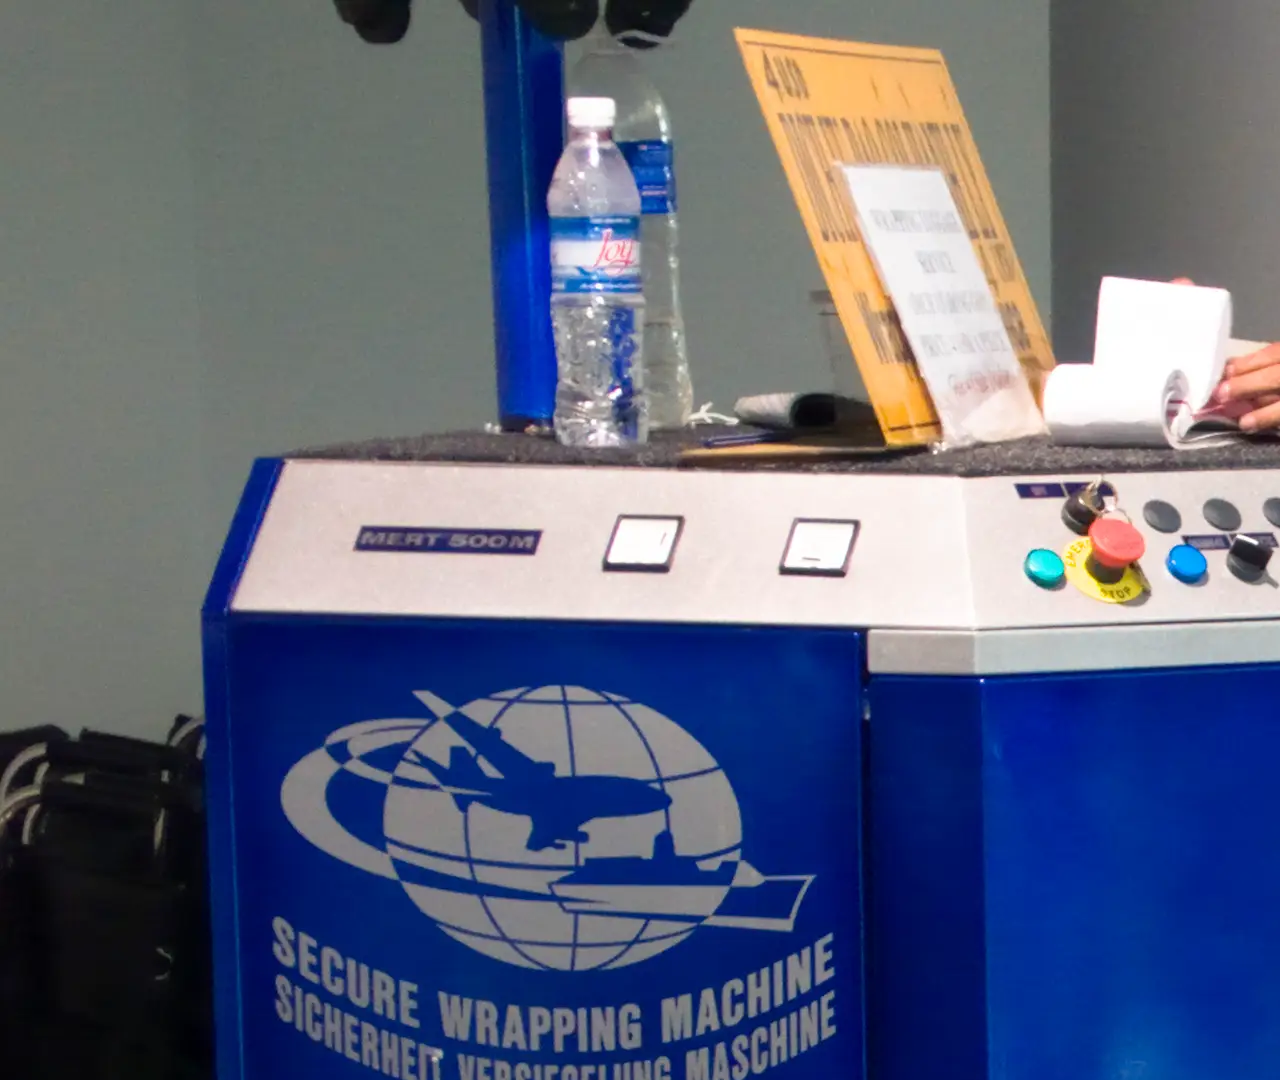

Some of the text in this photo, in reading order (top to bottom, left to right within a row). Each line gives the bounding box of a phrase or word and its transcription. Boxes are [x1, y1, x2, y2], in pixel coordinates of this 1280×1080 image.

[592, 229, 635, 276] Joy
[360, 530, 440, 546] MERT
[1100, 586, 1132, 599] STOP
[272, 916, 836, 1053] SECURE WRAPPING MACHINE
